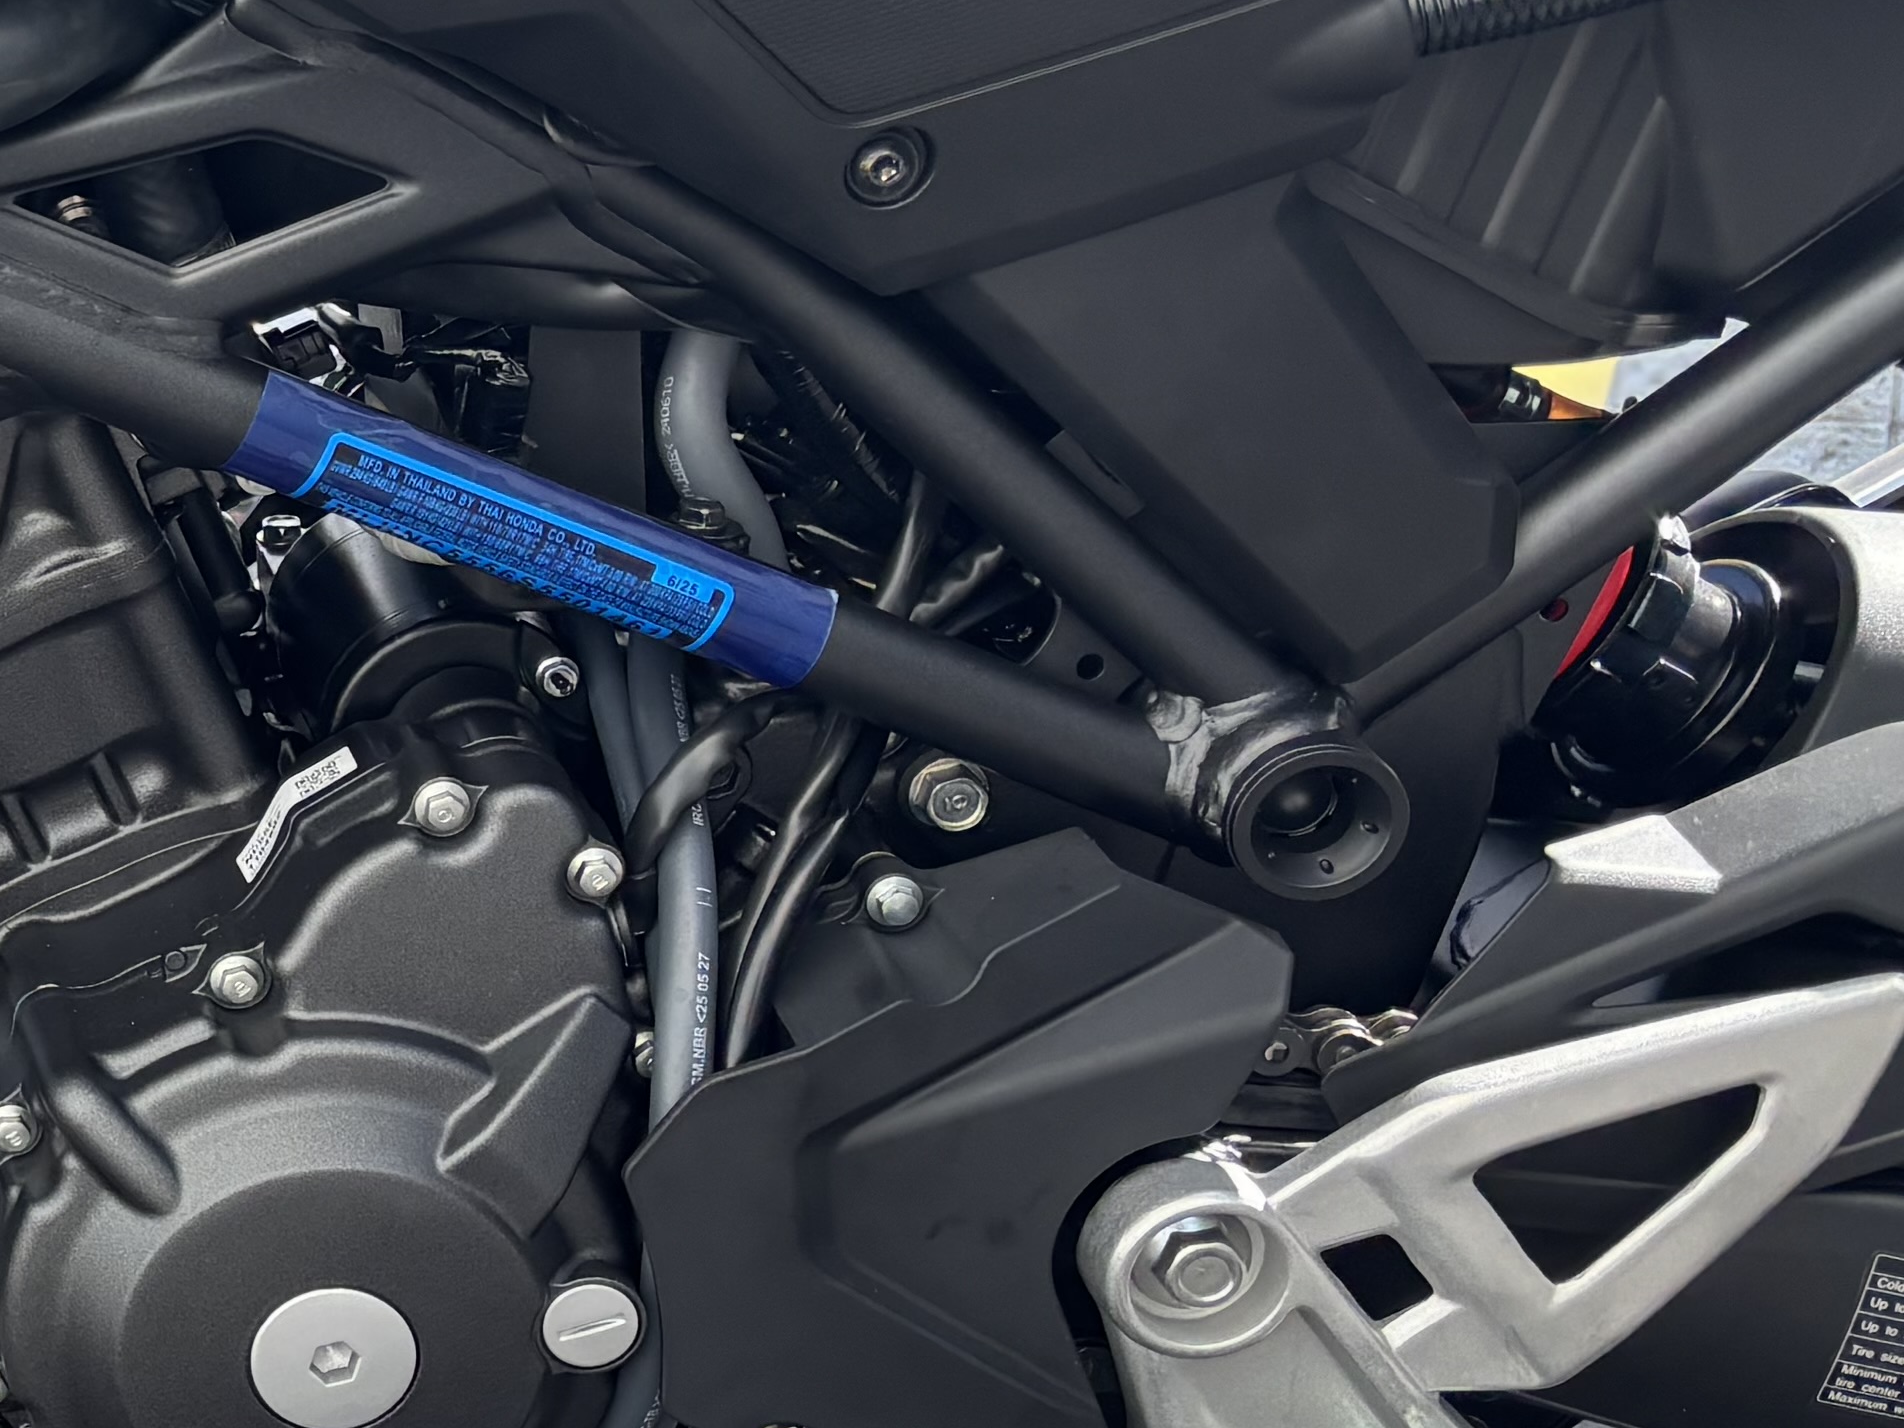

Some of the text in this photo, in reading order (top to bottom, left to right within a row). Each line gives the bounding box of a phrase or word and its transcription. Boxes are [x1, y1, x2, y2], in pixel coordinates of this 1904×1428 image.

[387, 465, 399, 479] IN
[402, 470, 457, 501] THAILAND
[458, 495, 475, 509] BY
[478, 501, 505, 523] THAI
[506, 512, 543, 536] HONDA
[573, 537, 596, 558] LTD.
[666, 575, 700, 595] 6/25
[698, 951, 711, 971] 27
[1869, 1296, 1889, 1312] Up
[1860, 1319, 1899, 1337] Up to
[1851, 1343, 1875, 1359] Tire
[1841, 1364, 1897, 1385] Minimum
[1835, 1376, 1901, 1399] tire center
[1827, 1389, 1888, 1411] Maximum
